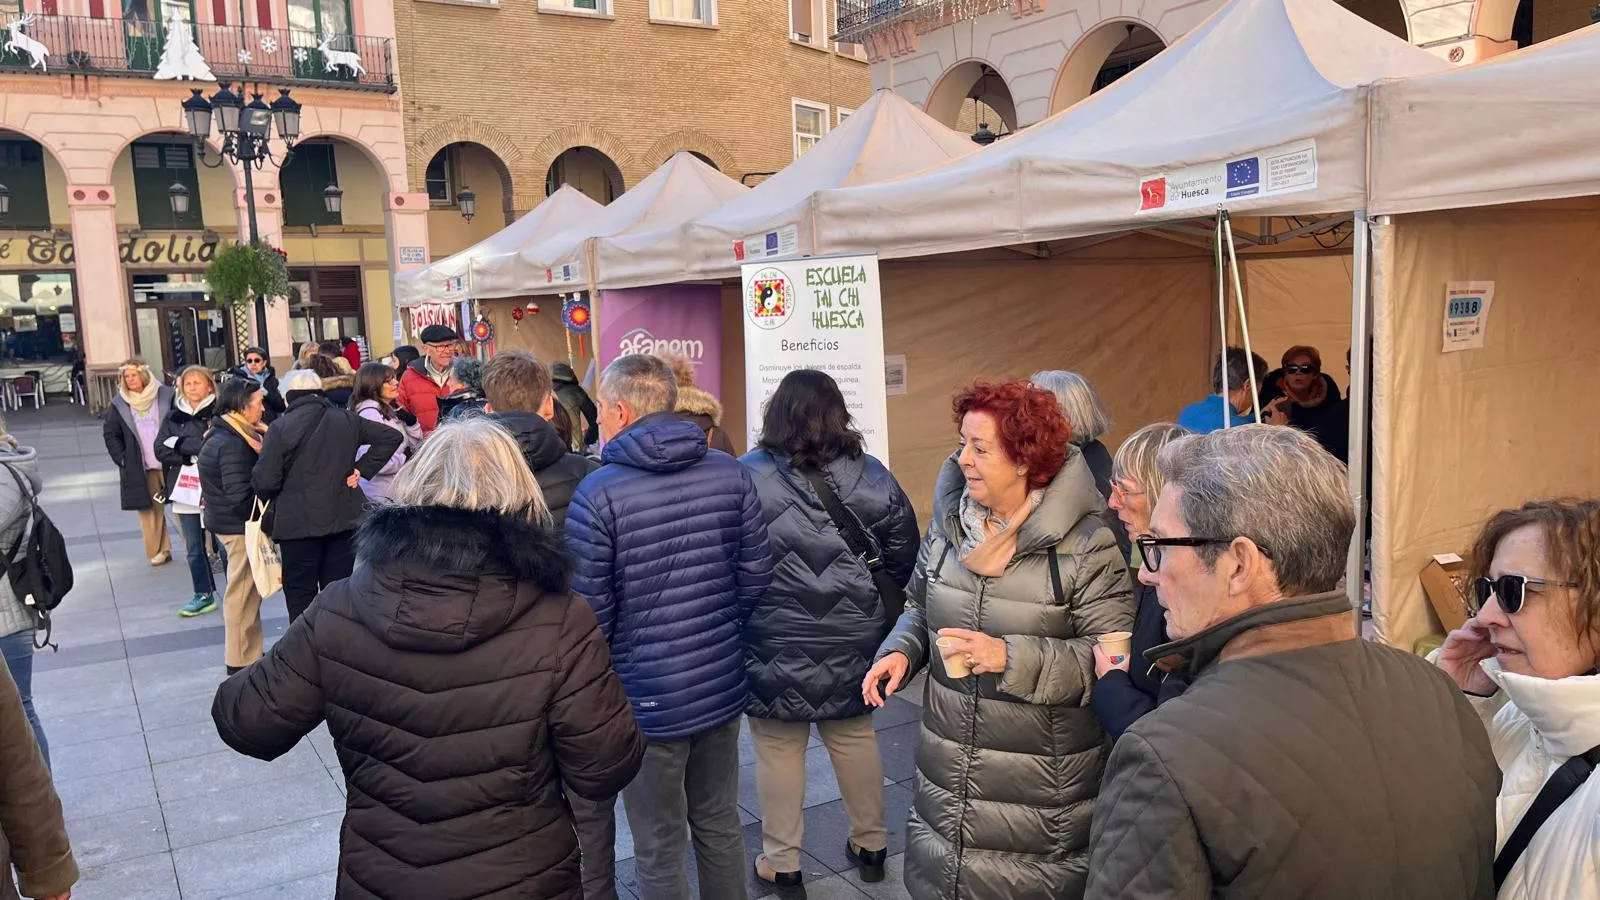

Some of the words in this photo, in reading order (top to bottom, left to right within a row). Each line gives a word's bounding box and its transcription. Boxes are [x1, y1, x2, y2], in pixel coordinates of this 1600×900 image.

[1181, 188, 1209, 199] Huesca
[806, 265, 866, 286] ESCUELA
[814, 289, 832, 308] TAI
[839, 287, 859, 307] CHI
[812, 309, 864, 329] HUESCA
[781, 338, 839, 351] Beneficios
